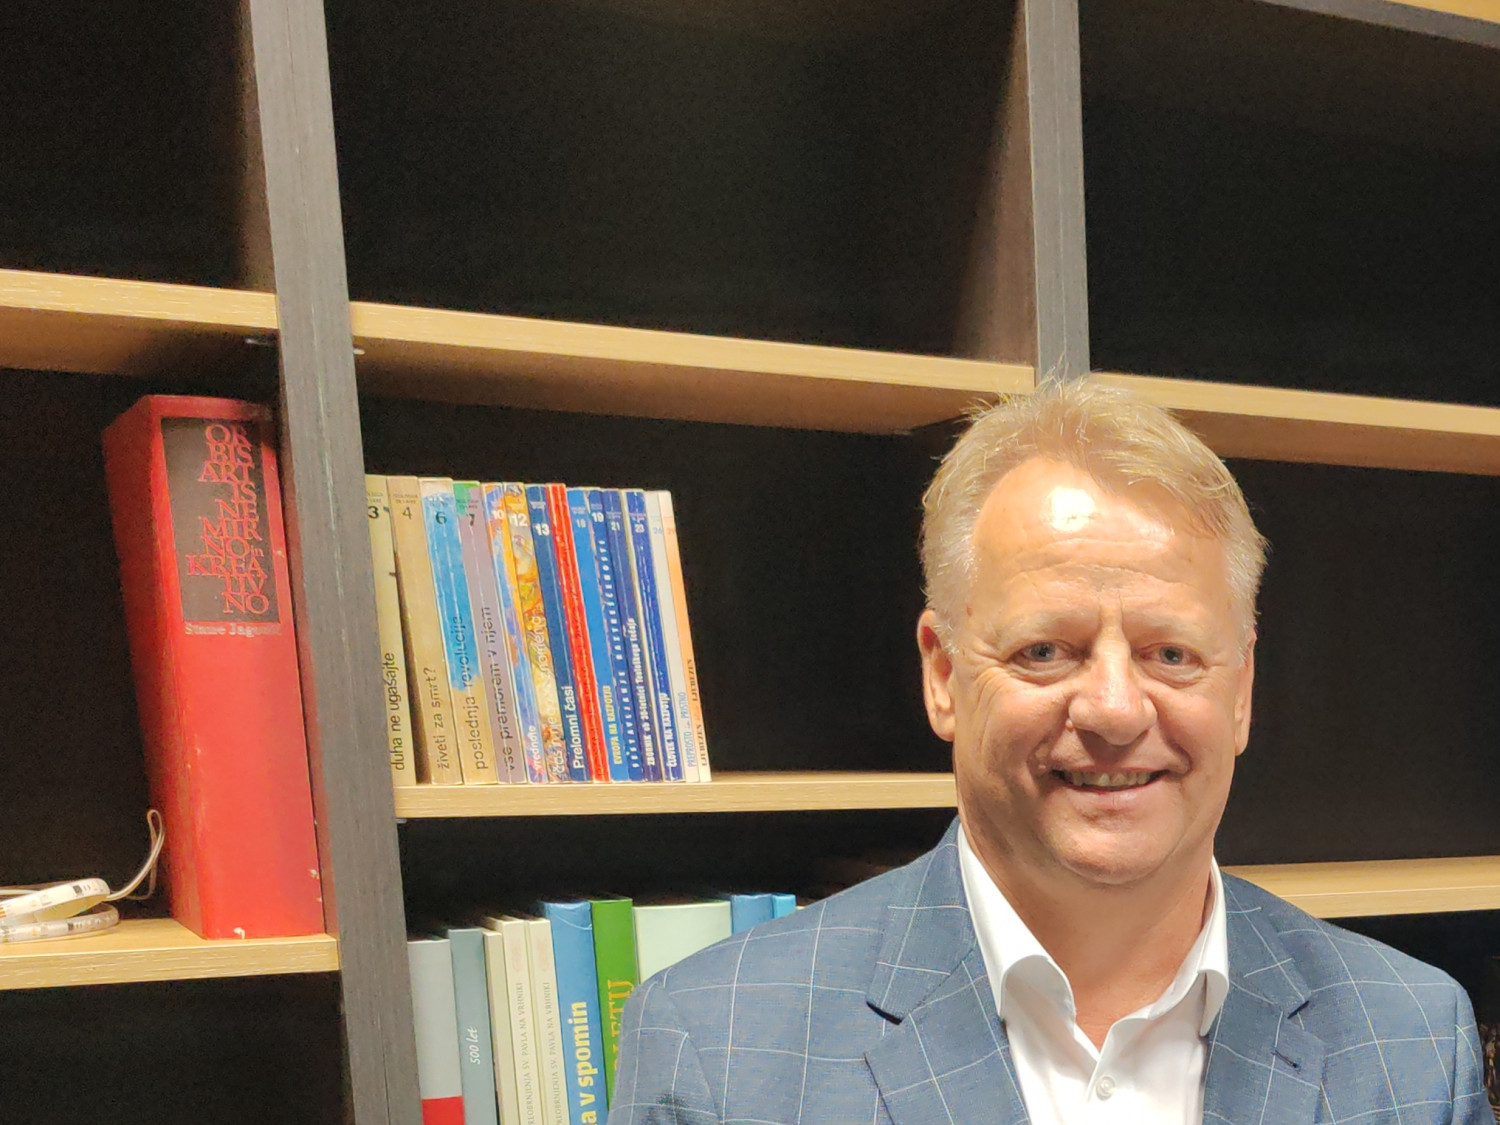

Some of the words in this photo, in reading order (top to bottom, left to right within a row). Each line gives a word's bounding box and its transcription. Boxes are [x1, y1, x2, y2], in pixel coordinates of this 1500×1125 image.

[208, 442, 253, 464] BIS
[198, 460, 255, 484] ART
[231, 481, 256, 501] IS
[215, 498, 260, 520] NE
[367, 505, 380, 519] 3
[401, 506, 413, 520] 4
[435, 511, 448, 525] 6
[492, 509, 505, 520] 10
[509, 513, 528, 527] 12
[591, 512, 604, 522] 19
[198, 516, 262, 541] MIR
[535, 523, 550, 536] 13
[201, 536, 250, 560] NO
[250, 545, 264, 558] in
[185, 554, 264, 577] KREA
[221, 591, 269, 614] NO
[479, 607, 497, 644] njem
[450, 616, 473, 688] revolucija
[487, 648, 497, 659] v
[488, 663, 514, 740] premorem
[561, 686, 575, 711] časi
[389, 715, 401, 732] ne
[432, 713, 444, 729] za
[609, 723, 618, 735] NA
[463, 696, 488, 770] poslednja
[566, 713, 585, 769] Prelomni
[662, 729, 673, 740] NA
[390, 737, 405, 770] duha
[433, 735, 450, 770] živeti
[501, 747, 515, 773] vse
[611, 736, 622, 764] EVROPA
[644, 735, 656, 766] ZBORNIK
[664, 741, 678, 768] ČLOVEK
[516, 982, 525, 1015] VRHNIKI
[543, 982, 553, 1015] VRHNIKI
[466, 1026, 478, 1043] let
[519, 1018, 526, 1029] NA
[546, 1017, 553, 1029] NA
[469, 1044, 481, 1065] 500
[520, 1032, 528, 1056] PAVLA
[548, 1031, 556, 1055] PAVLA
[567, 1001, 598, 1087] spomin
[580, 1092, 595, 1106] v
